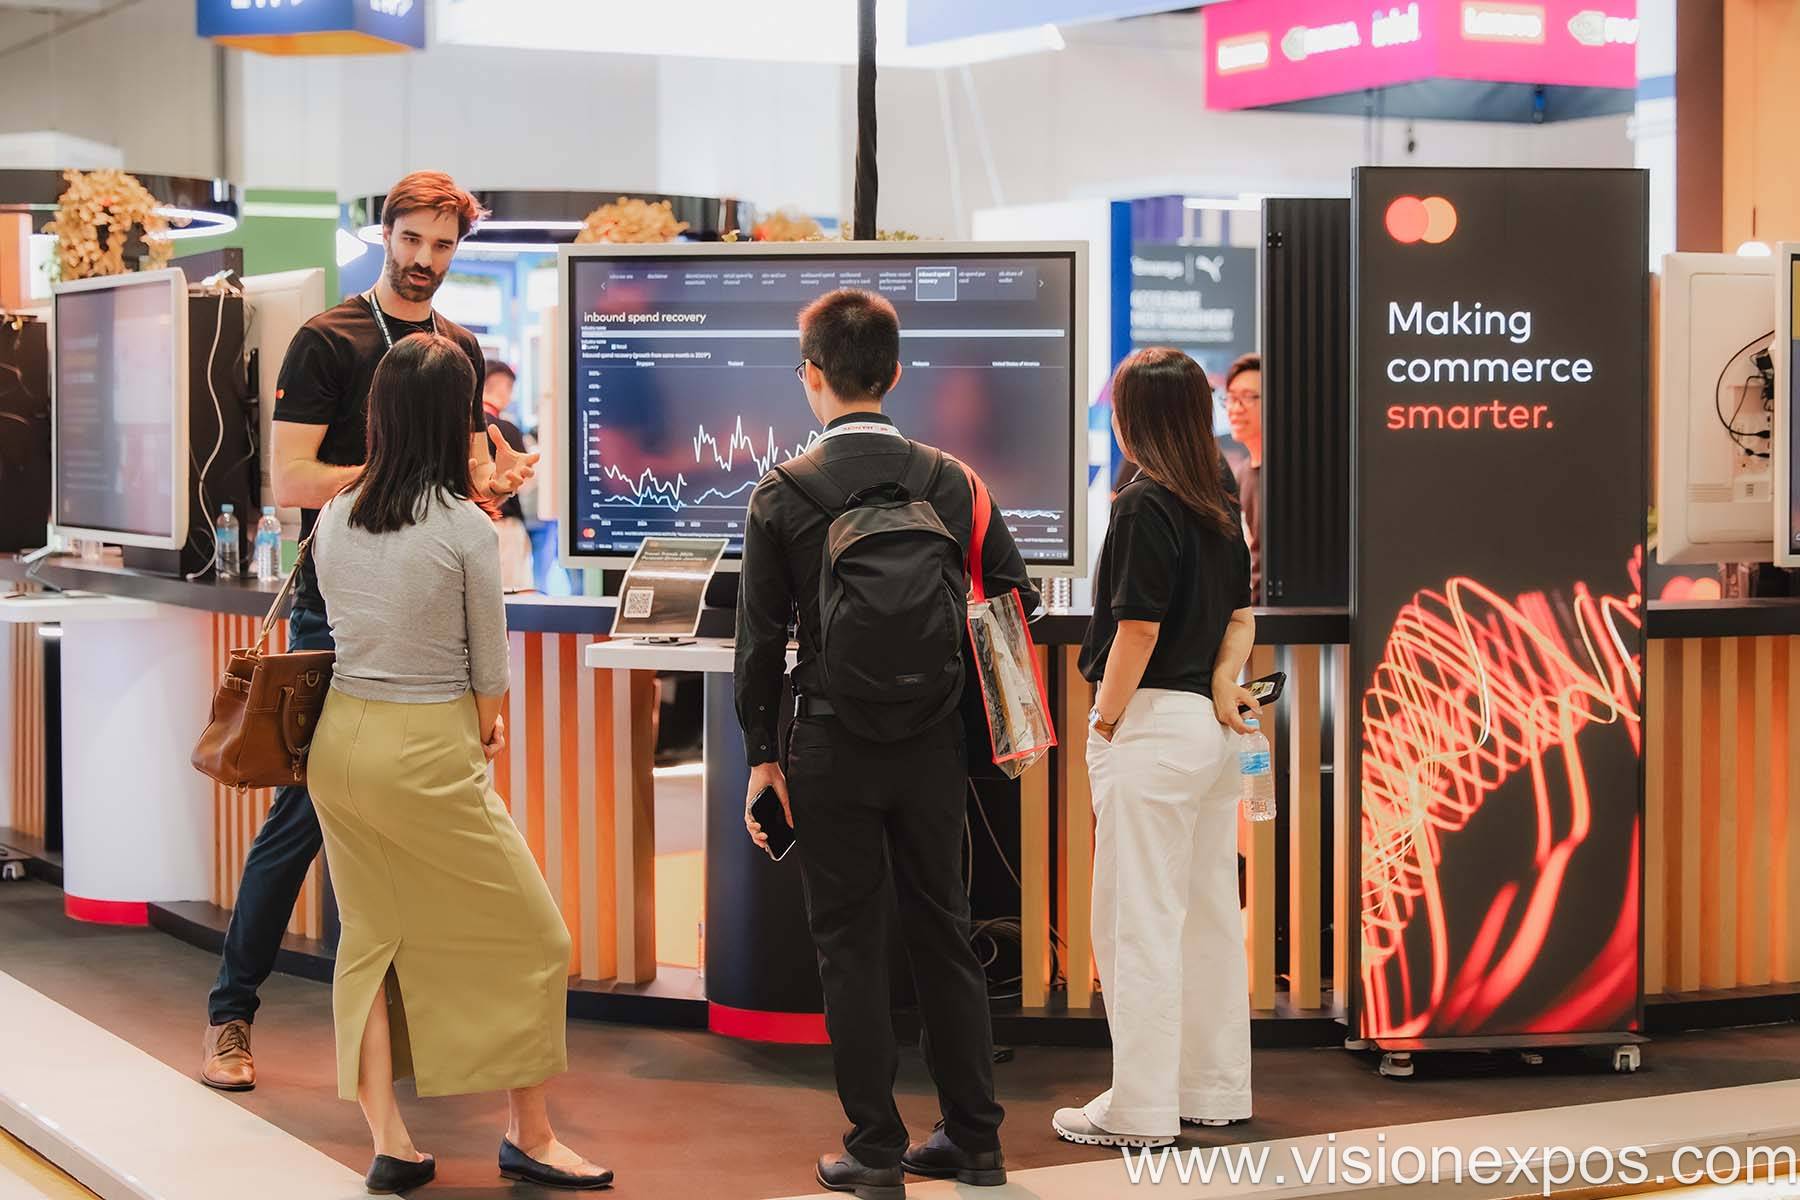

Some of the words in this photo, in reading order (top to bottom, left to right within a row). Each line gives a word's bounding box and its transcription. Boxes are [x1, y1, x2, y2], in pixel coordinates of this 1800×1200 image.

[584, 312, 626, 322] inbound
[627, 312, 660, 325] spend
[661, 313, 707, 325] recovery
[1388, 301, 1532, 344] Making
[1386, 358, 1594, 383] commerce
[1386, 400, 1554, 430] smarter.
